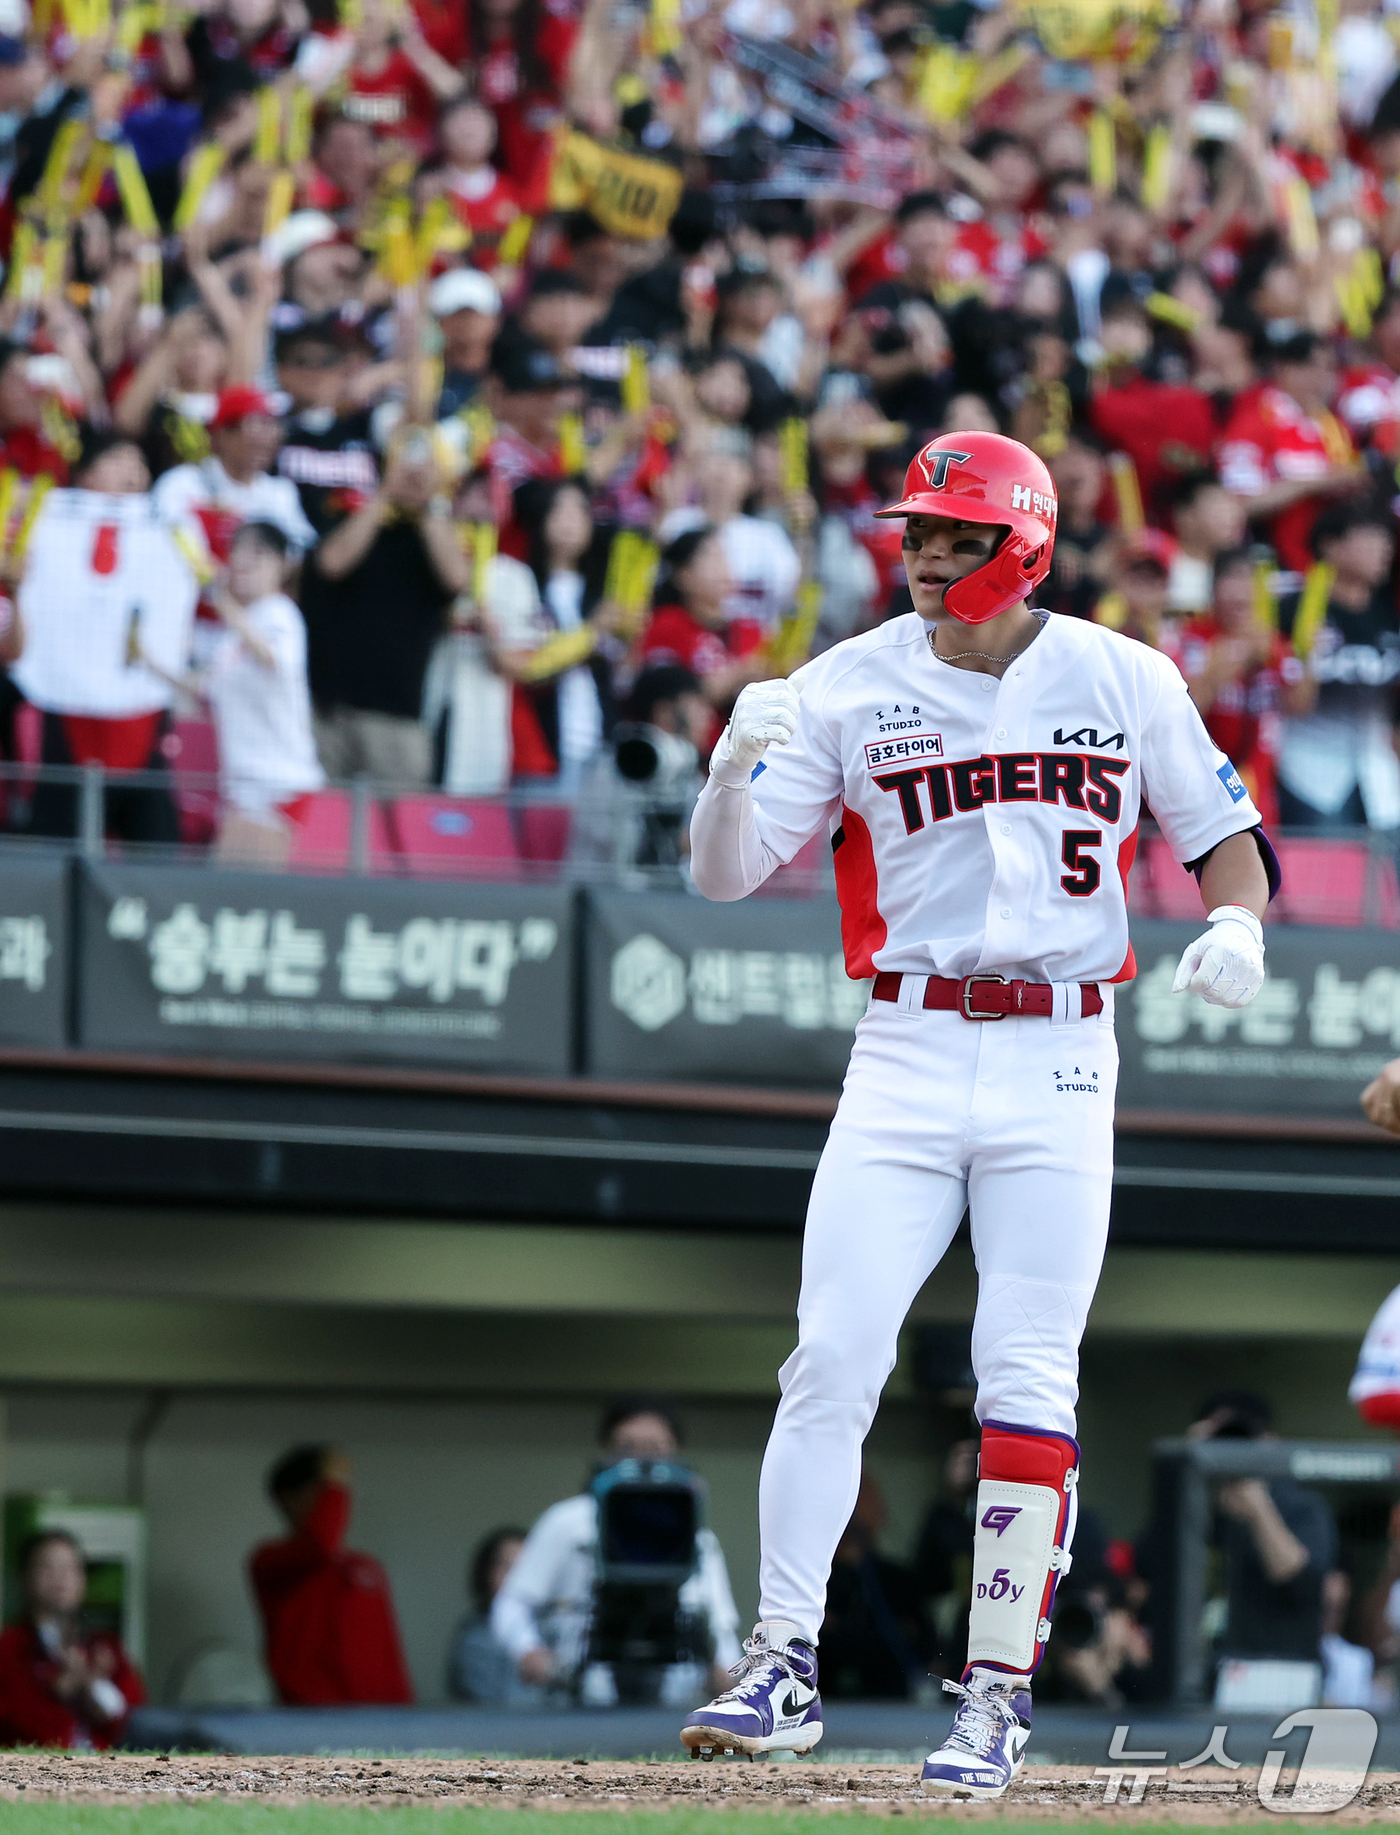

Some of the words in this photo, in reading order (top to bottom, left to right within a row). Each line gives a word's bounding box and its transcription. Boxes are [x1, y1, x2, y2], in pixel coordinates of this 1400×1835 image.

[926, 449, 975, 489] T
[879, 719, 922, 732] STUDIO
[869, 738, 940, 763] 금호타이어
[1053, 728, 1124, 751] KIA
[871, 752, 1131, 836] TIGERS
[1060, 829, 1102, 897] 5
[1056, 1083, 1099, 1093] STUDIO
[960, 1772, 975, 1784] THE
